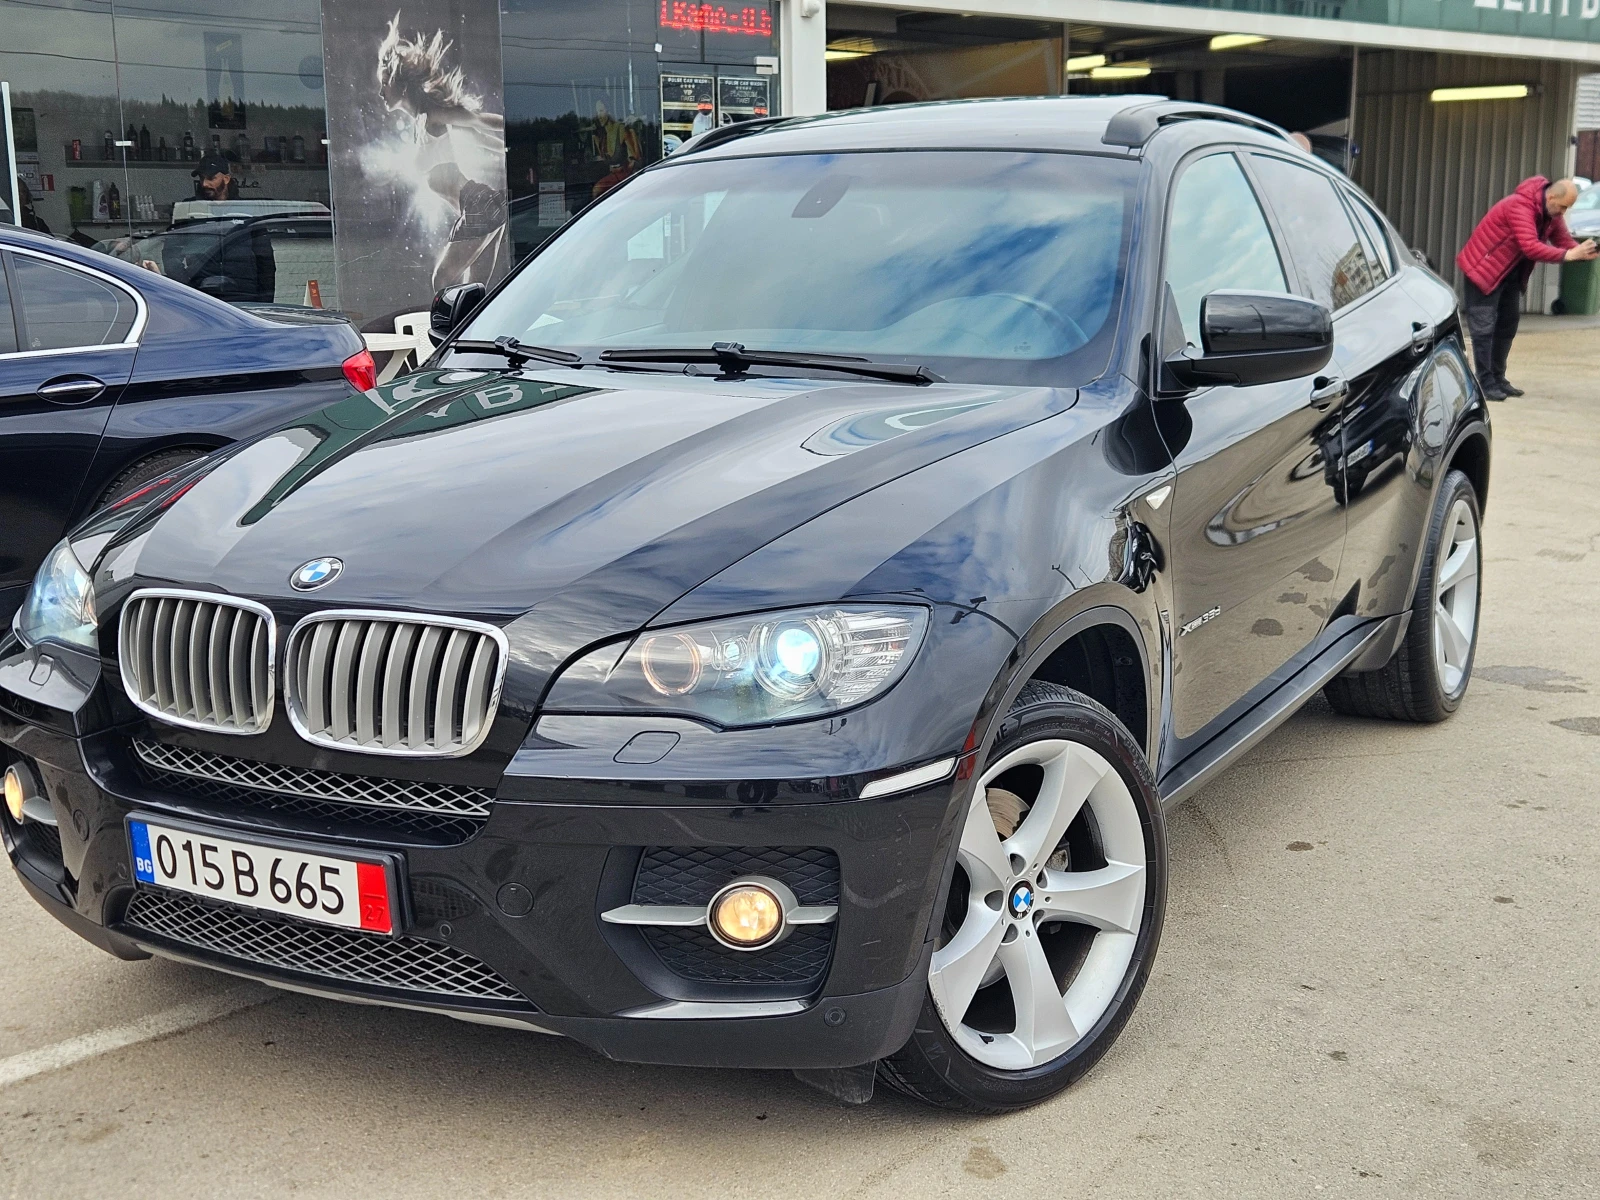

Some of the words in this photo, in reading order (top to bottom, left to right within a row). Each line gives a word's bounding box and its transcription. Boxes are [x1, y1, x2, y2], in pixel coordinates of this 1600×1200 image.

[133, 460, 170, 481] KUMHO
[136, 856, 153, 874] BG
[365, 904, 385, 923] 27
